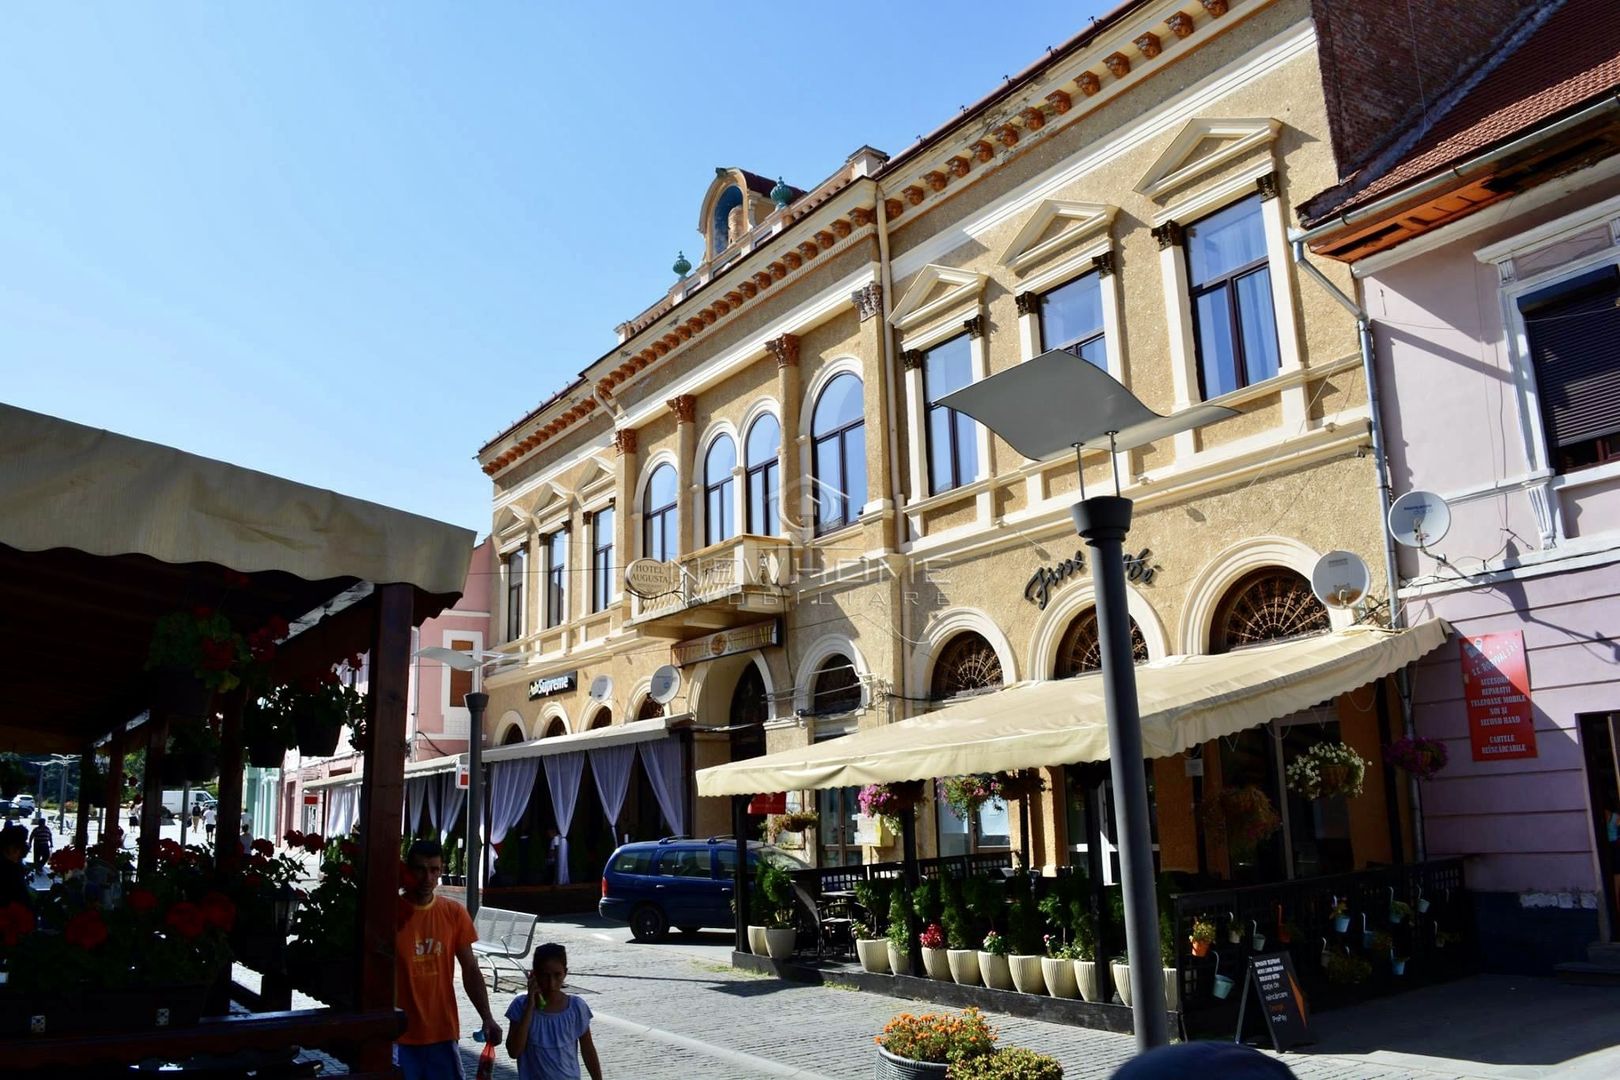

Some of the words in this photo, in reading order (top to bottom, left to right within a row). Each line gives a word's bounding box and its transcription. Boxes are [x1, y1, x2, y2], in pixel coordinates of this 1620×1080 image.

[635, 564, 665, 574] HOTEL
[631, 573, 668, 584] AUGUSTA
[538, 676, 569, 696] Supreme
